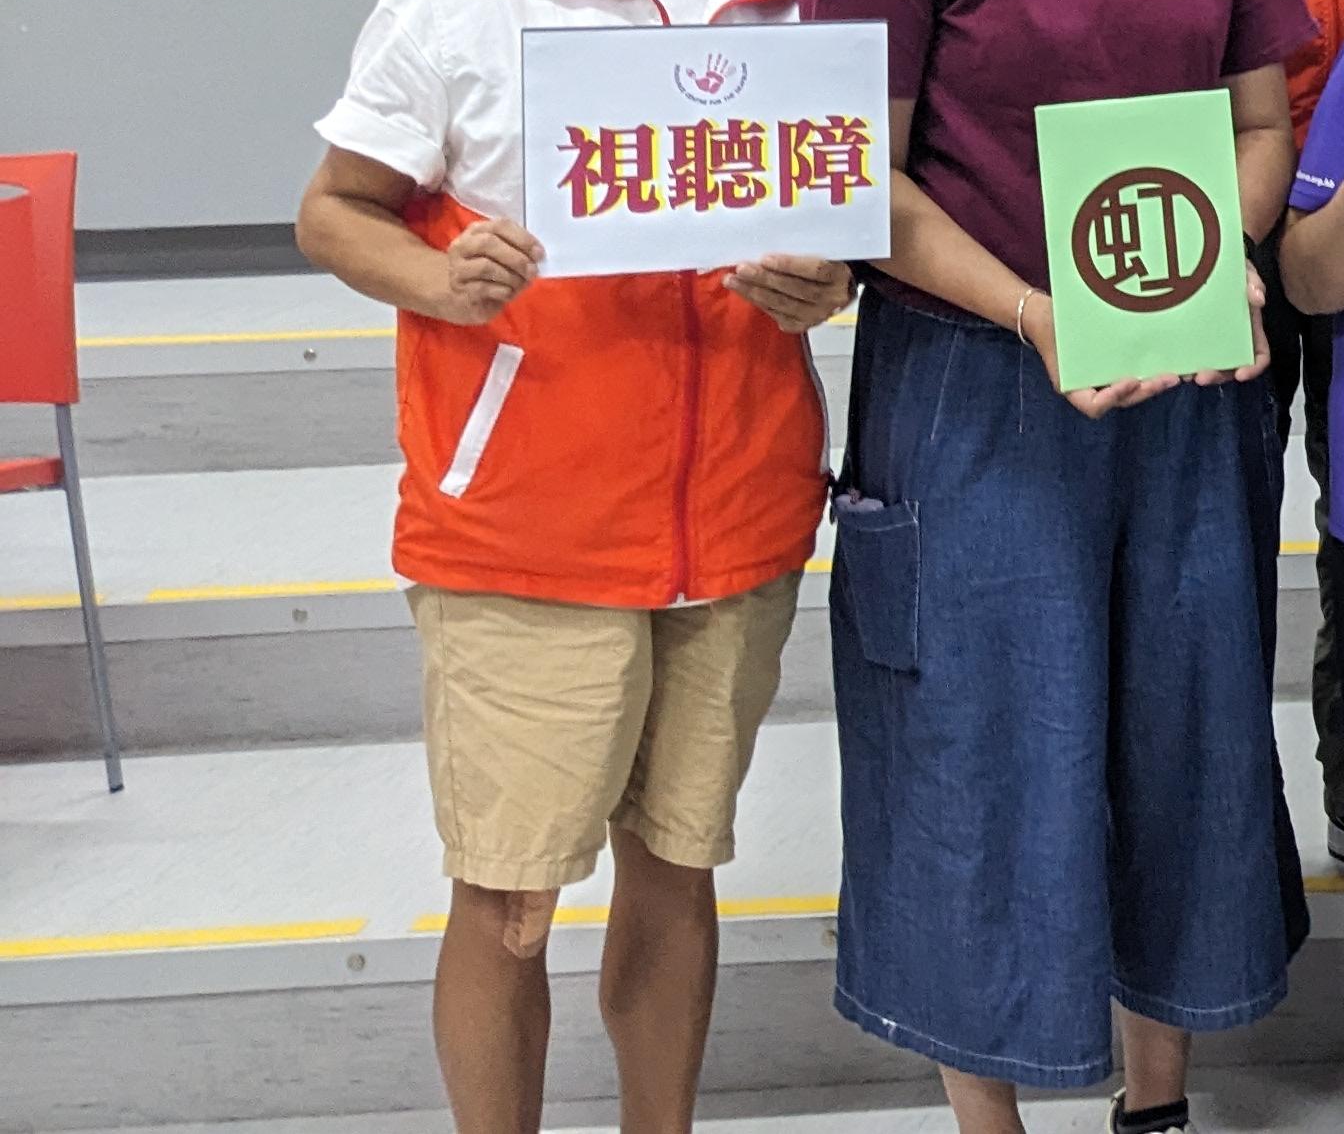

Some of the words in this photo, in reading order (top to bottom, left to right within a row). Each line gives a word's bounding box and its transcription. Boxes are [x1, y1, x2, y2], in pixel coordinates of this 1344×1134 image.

[557, 116, 874, 219] 視聽障
[1093, 182, 1195, 292] 虹
